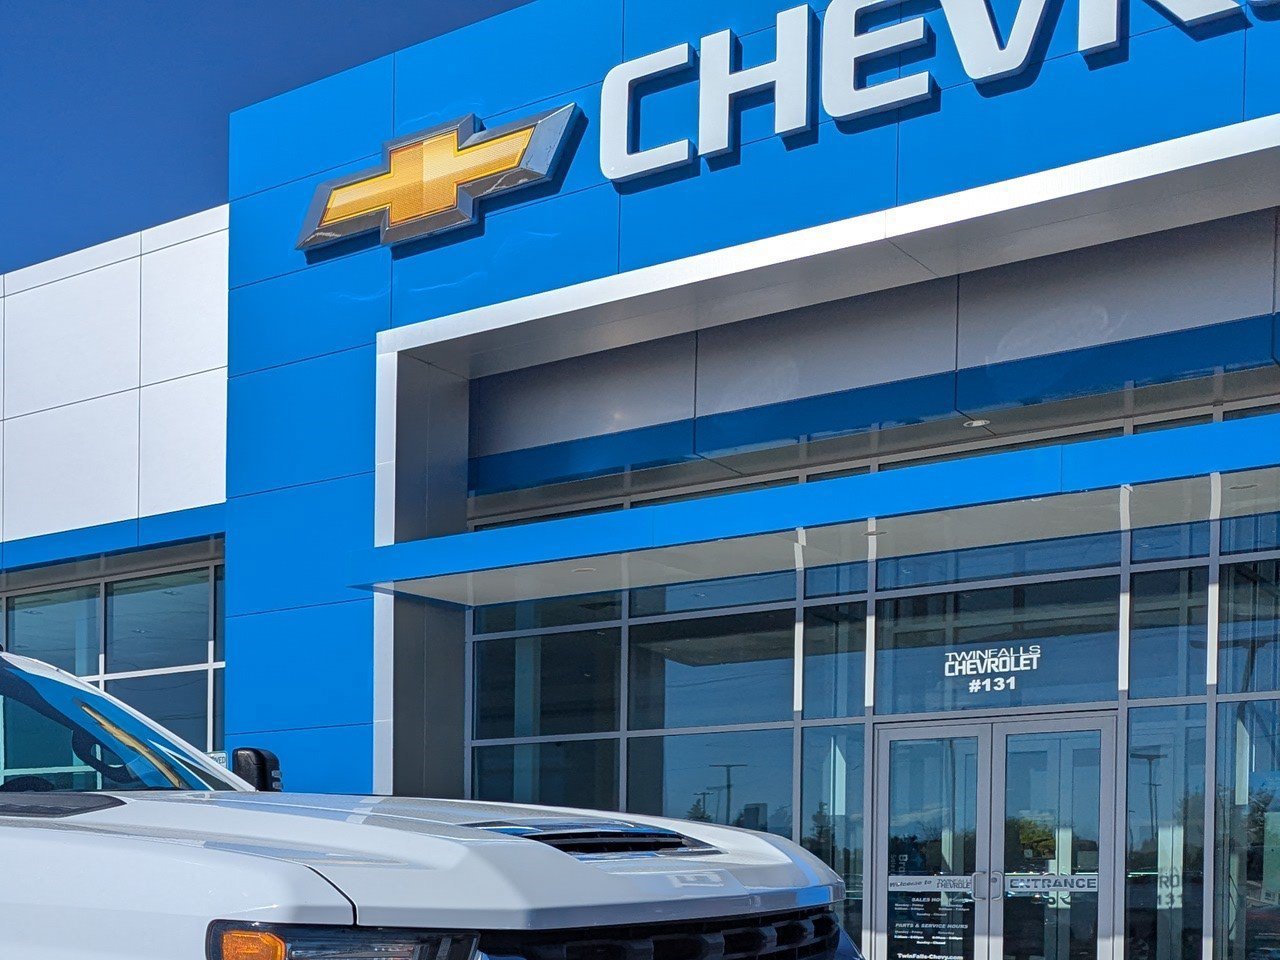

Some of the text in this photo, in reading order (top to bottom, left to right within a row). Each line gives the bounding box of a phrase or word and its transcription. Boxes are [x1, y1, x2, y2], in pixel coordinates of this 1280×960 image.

[600, 0, 1280, 183] CHEV
[945, 654, 1041, 676] CHEVROLET
[969, 676, 1016, 693] #131
[1009, 878, 1097, 889] ENTRANCE
